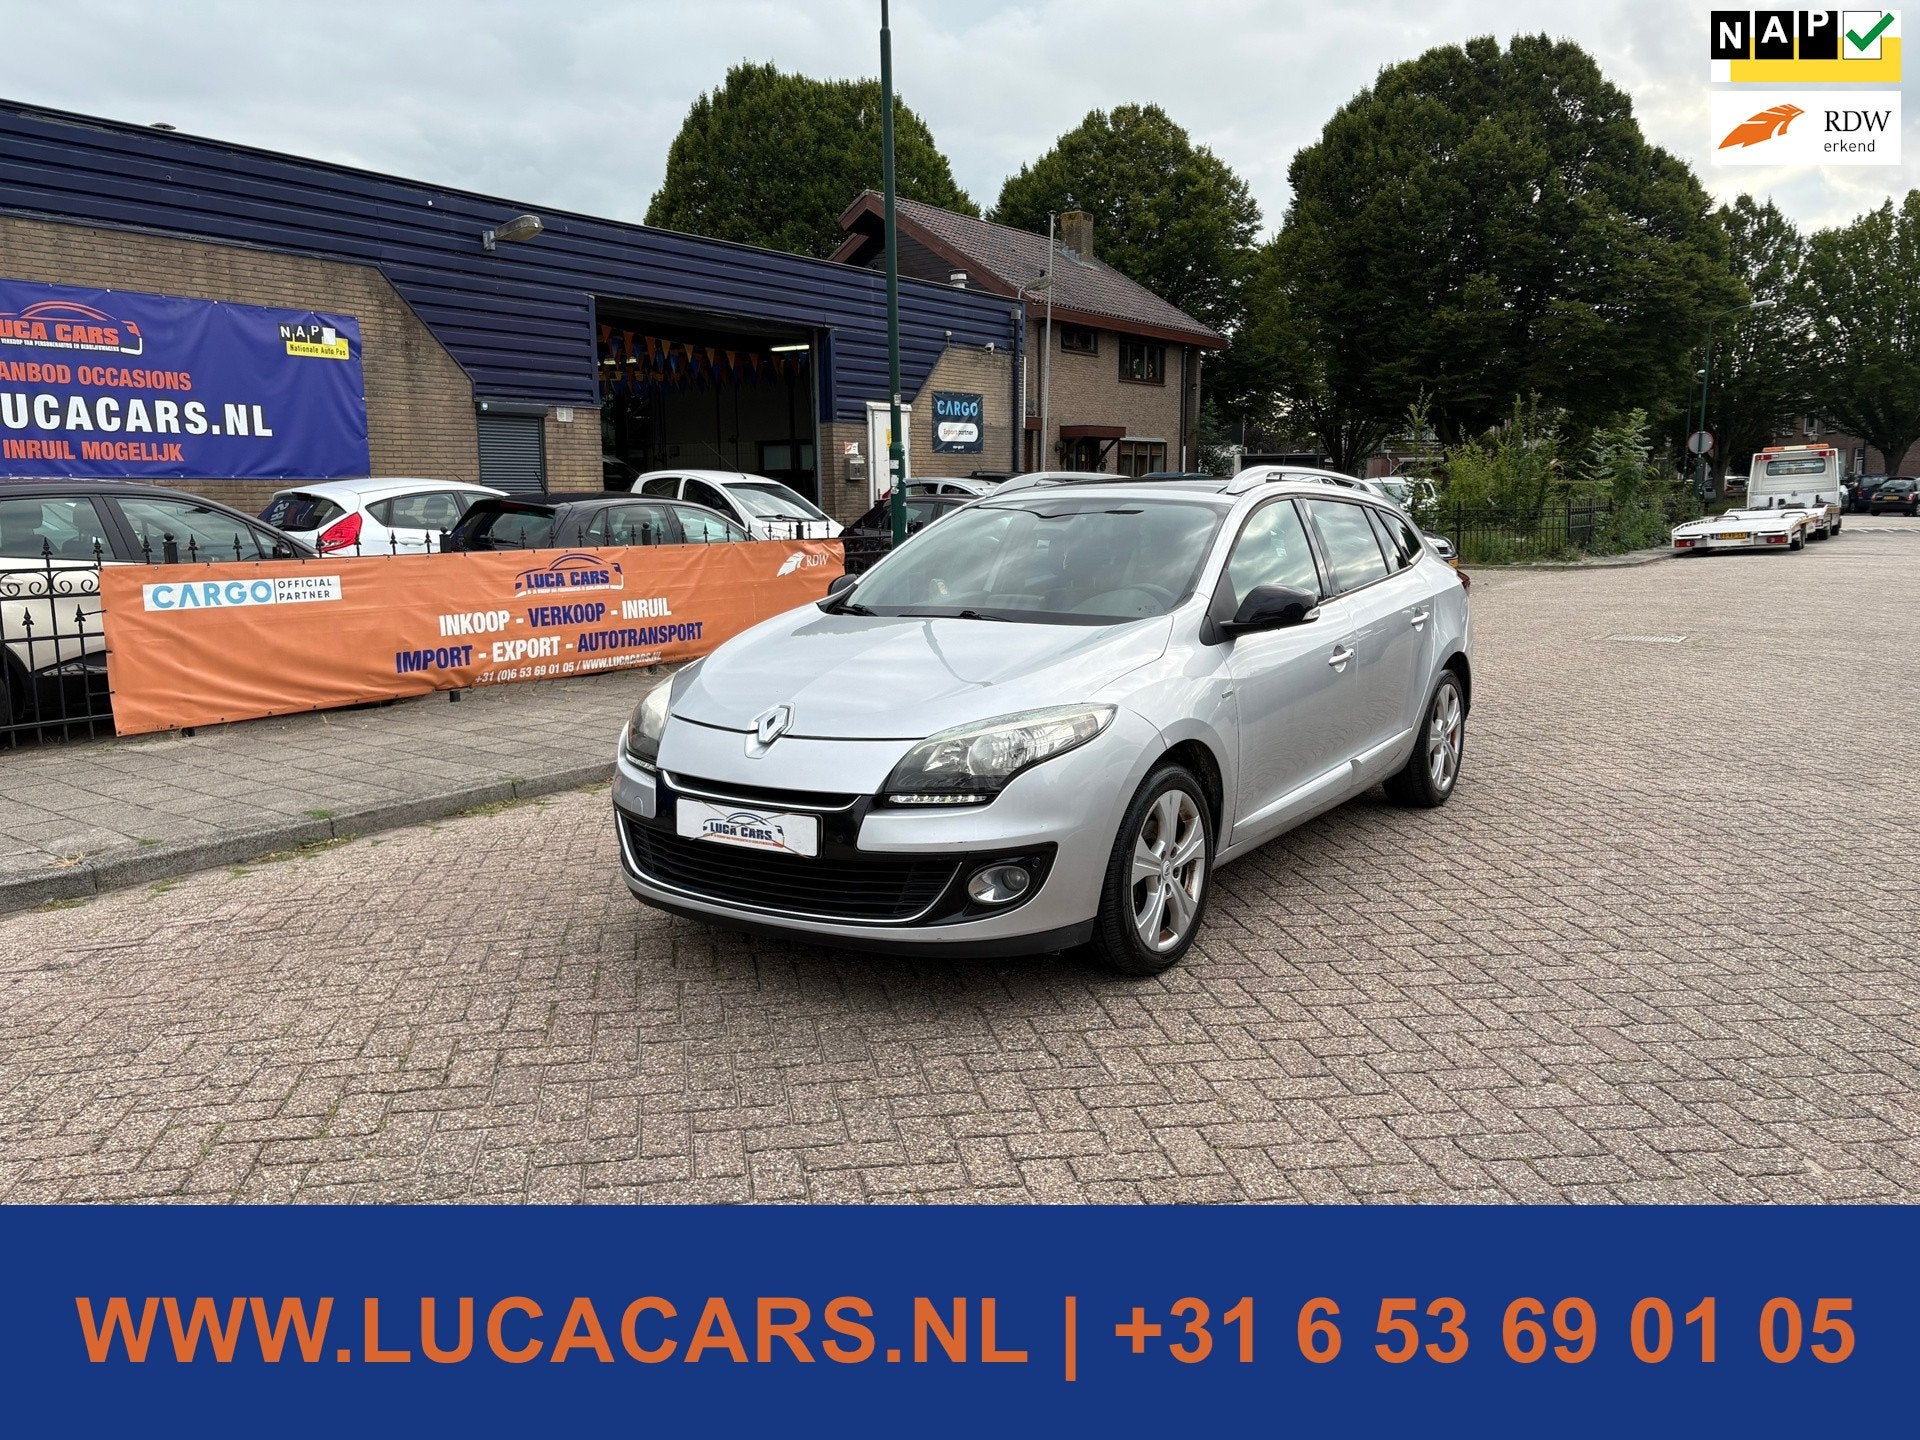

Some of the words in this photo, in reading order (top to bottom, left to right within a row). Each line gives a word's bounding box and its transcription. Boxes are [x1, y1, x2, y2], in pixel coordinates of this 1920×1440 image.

[55, 323, 119, 345] CARS
[290, 344, 318, 353] Nationale
[321, 347, 334, 355] Auto
[78, 365, 192, 391] OCCASIONS
[937, 400, 978, 416] CARGO
[3, 439, 76, 461] INRUIL
[81, 440, 184, 462] MOGELIJK
[806, 554, 829, 566] RDW
[277, 578, 332, 589] OFFICIAL
[526, 572, 565, 589] LUCA
[570, 570, 609, 585] CARS
[152, 581, 272, 609] CARGO
[279, 590, 331, 601] PARTNER
[439, 610, 510, 637] INKOOP
[528, 602, 606, 628] VERKOOP
[622, 597, 672, 620] INRUIL
[396, 645, 473, 673] IMPORT
[492, 635, 561, 663] EXPORT
[577, 622, 703, 652] AUTOTRANSPORT
[475, 671, 494, 683] +31
[497, 668, 517, 682] (0)6
[519, 667, 531, 678] 53
[534, 665, 546, 676] 69
[549, 663, 560, 674] 01
[563, 662, 574, 672] 05
[710, 821, 737, 836] LUCA
[741, 827, 773, 841] CARS
